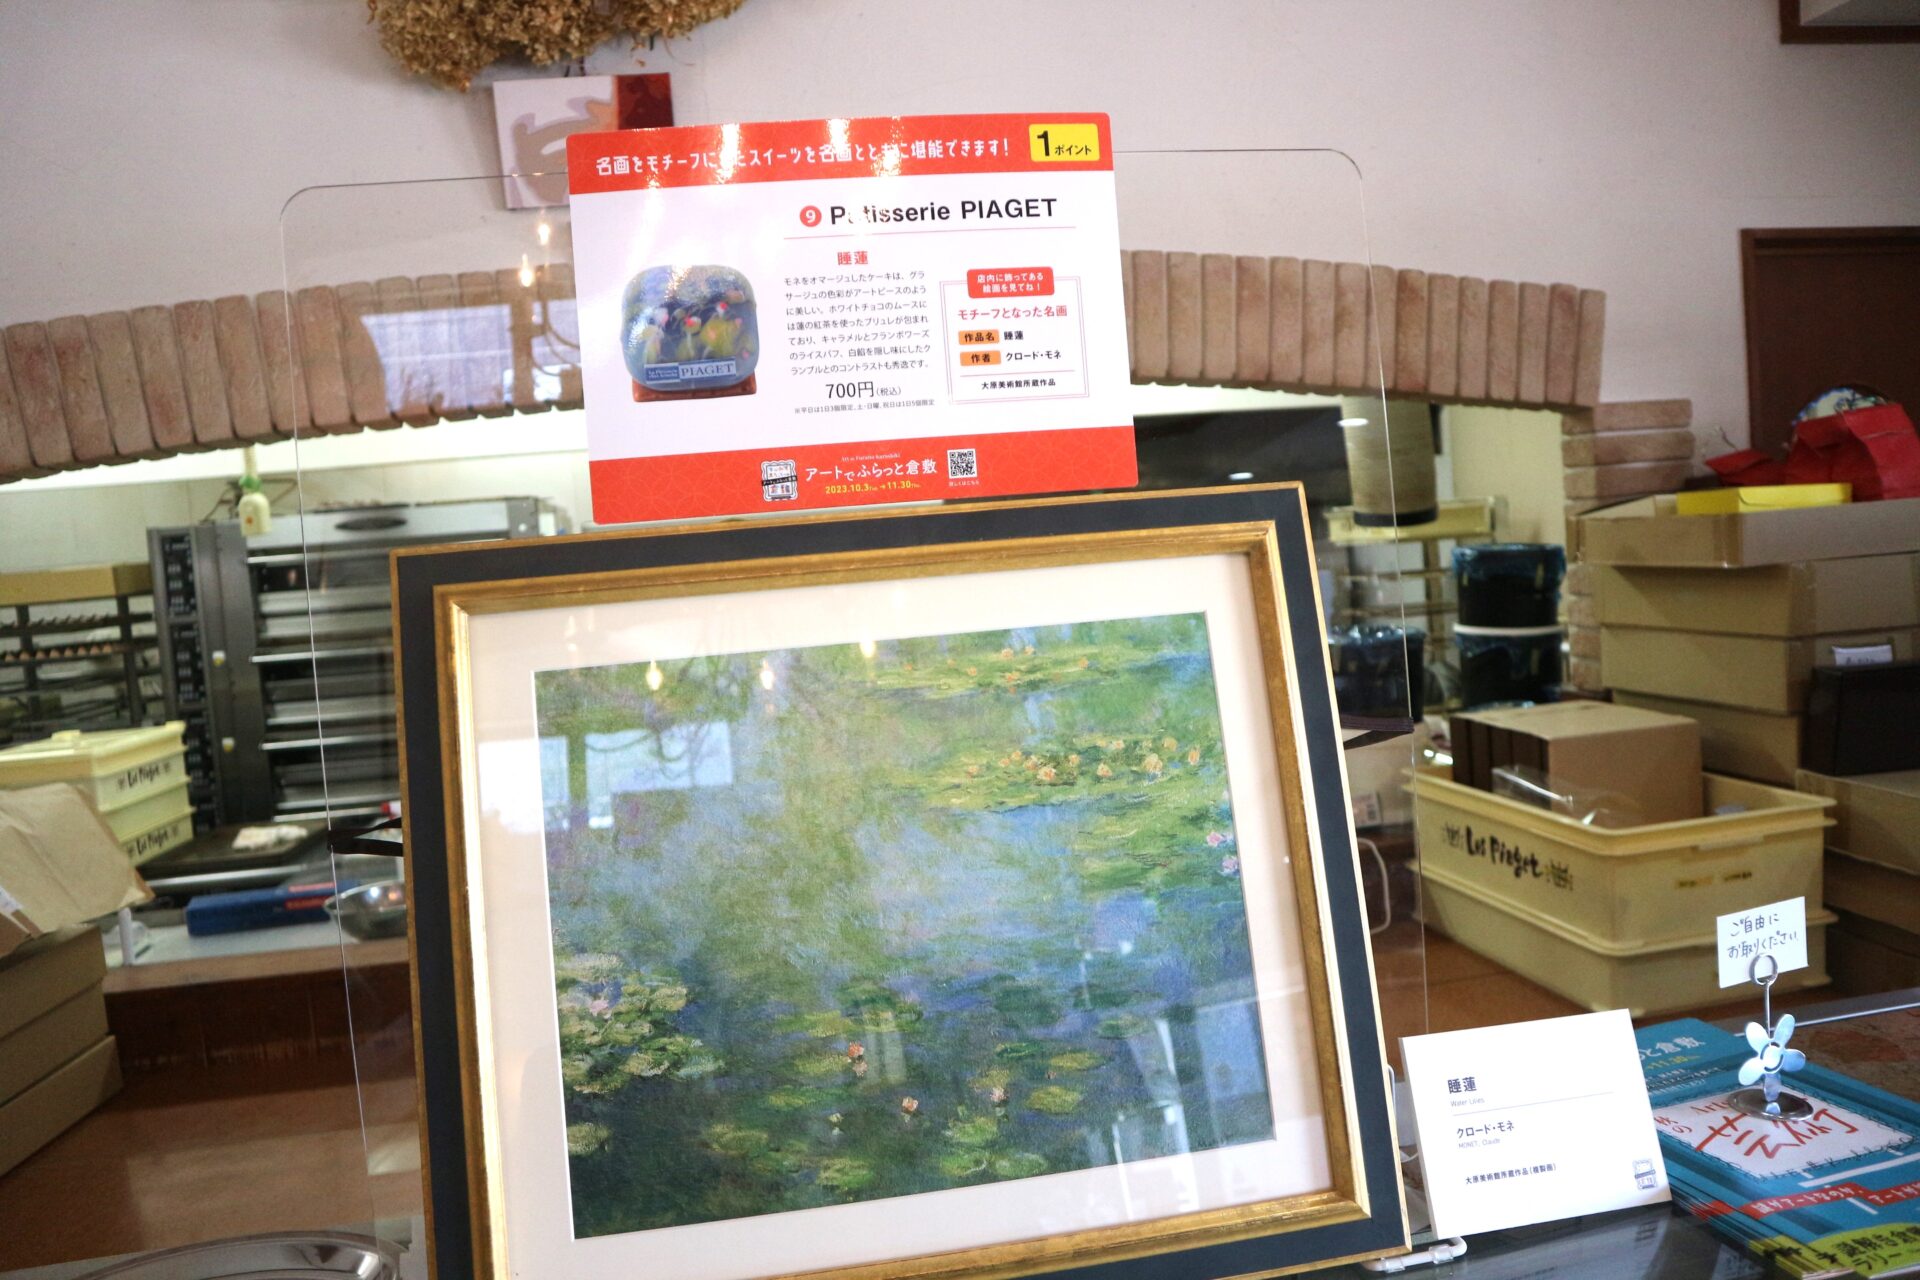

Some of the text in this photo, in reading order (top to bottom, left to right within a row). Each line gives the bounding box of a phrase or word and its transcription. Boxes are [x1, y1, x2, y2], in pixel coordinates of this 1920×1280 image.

[596, 139, 1009, 176] 名画をモチーフにたスイーツを名画ととに堪能できます!
[831, 201, 951, 225] Ptisserie
[961, 198, 1057, 219] PIAGET
[837, 250, 868, 265] 睡蓮
[977, 272, 1044, 284] 店内に飾ってある
[982, 283, 1041, 293] 絵画を見てね!
[958, 305, 1067, 320] モチーフとなった名画
[964, 330, 1024, 342] 作品名 睡蓮
[971, 350, 1062, 363] 作者 クロード・モネ
[681, 363, 734, 376] PIAGET
[981, 378, 1056, 390] 大原美術館所蔵作品
[805, 458, 938, 482] アートでふらっと倉敷
[1730, 913, 1780, 937] ご自由に
[1727, 931, 1799, 959] お取りください
[1447, 1076, 1477, 1094] 睡蓮
[1456, 1120, 1515, 1139] クロード・モネ
